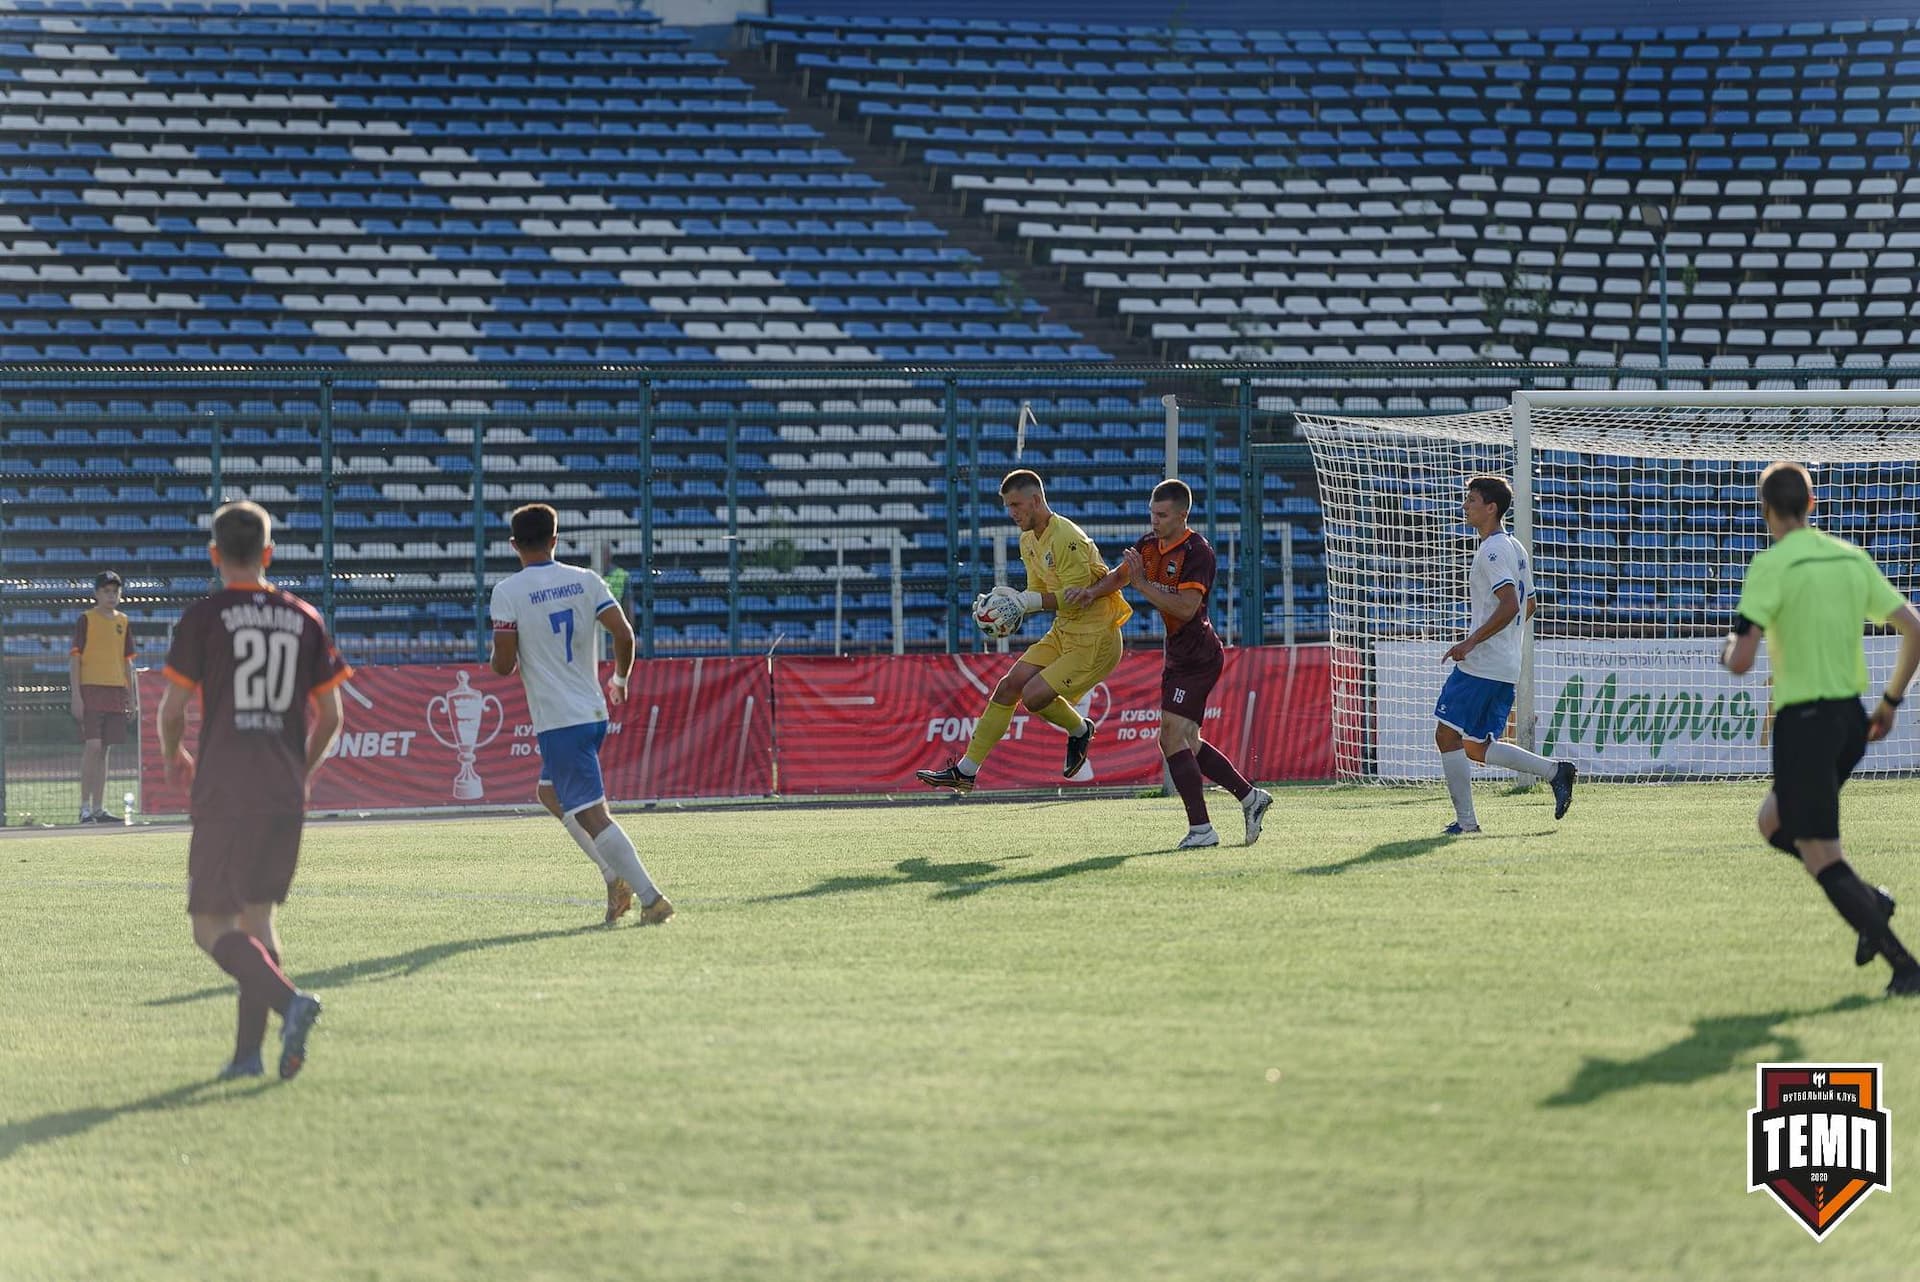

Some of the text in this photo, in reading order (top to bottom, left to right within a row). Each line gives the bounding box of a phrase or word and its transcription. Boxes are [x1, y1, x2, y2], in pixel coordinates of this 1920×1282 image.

[529, 583, 584, 605] ЖИТНИКОВ
[549, 608, 574, 664] 7
[233, 628, 300, 713] 20
[926, 715, 1030, 742] FONT
[1542, 672, 1757, 759] Мария
[1117, 728, 1136, 740] ПО
[510, 743, 531, 756] ПО
